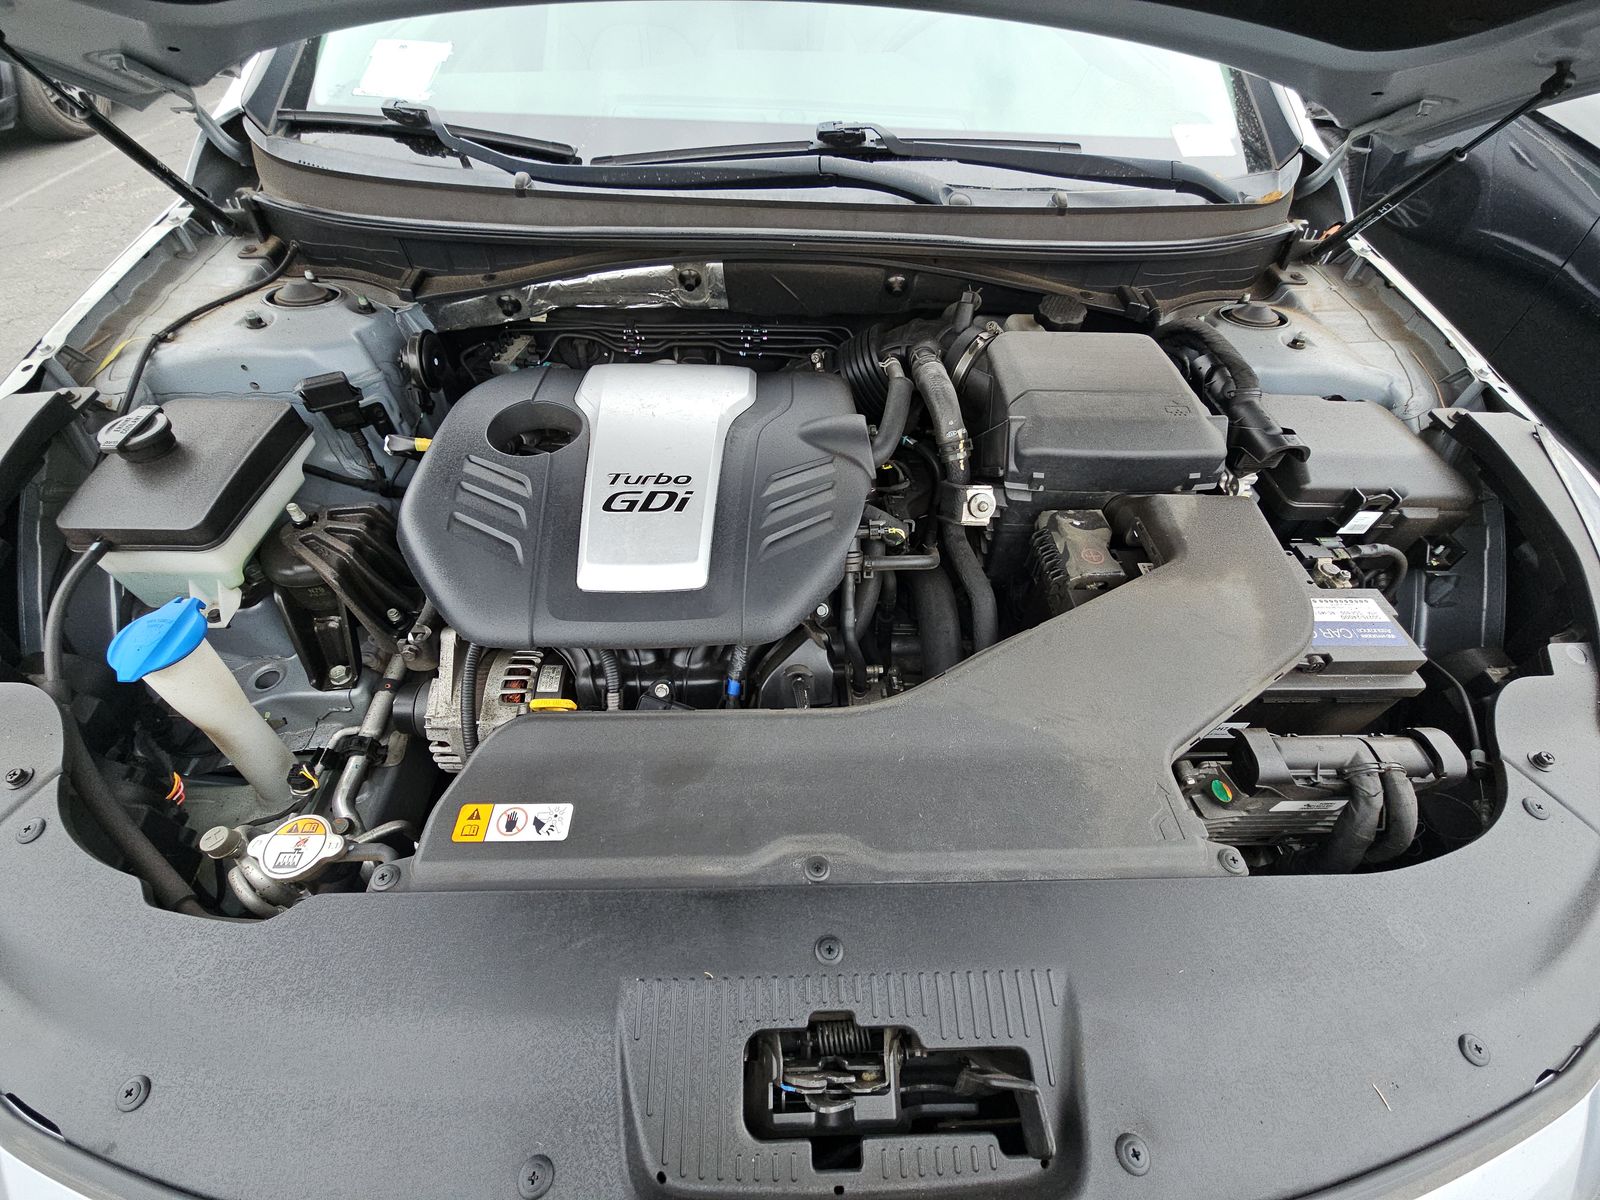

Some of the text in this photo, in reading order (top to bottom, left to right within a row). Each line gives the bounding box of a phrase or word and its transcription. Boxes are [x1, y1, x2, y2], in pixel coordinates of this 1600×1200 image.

[607, 472, 692, 486] Turbo
[602, 490, 695, 513] GDi
[1319, 627, 1353, 640] CAR
